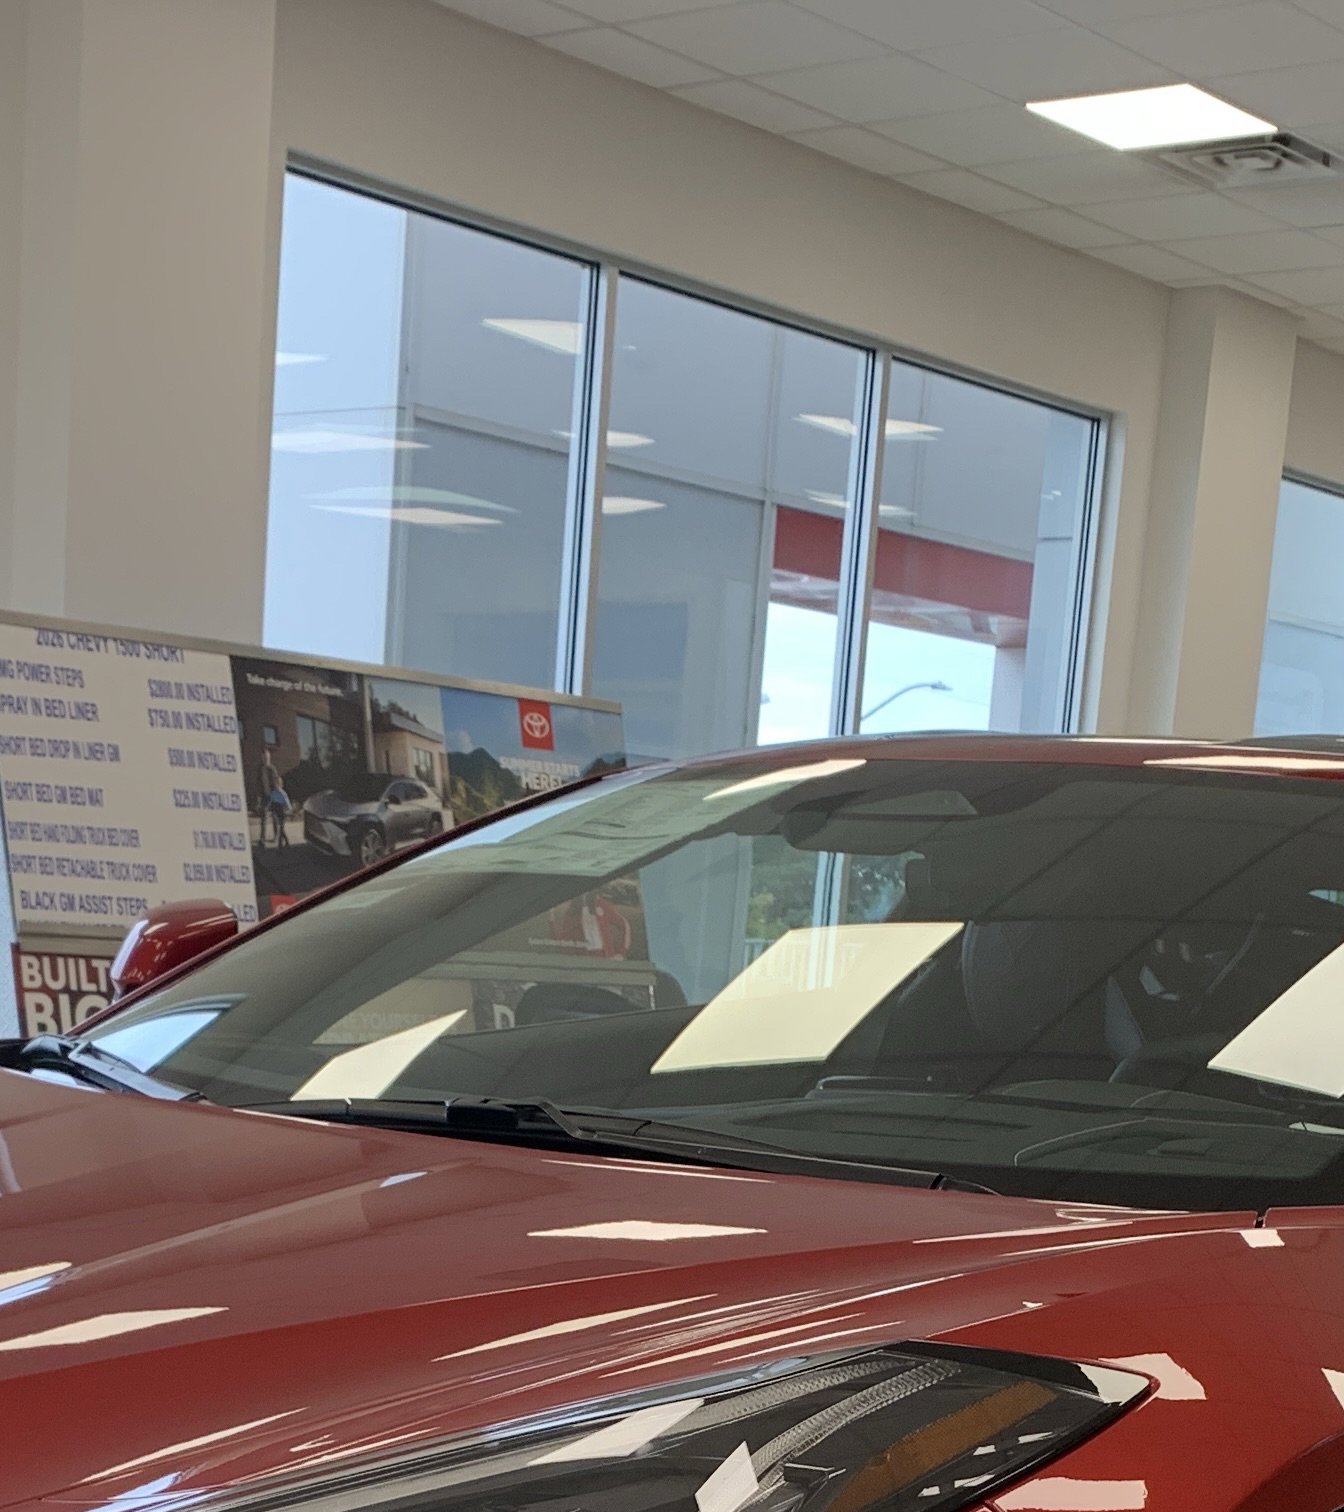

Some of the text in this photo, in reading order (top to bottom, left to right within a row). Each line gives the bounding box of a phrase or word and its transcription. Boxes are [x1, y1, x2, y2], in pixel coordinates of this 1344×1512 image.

[67, 632, 110, 654] CHEVY
[114, 637, 141, 658] 1500
[144, 643, 186, 664] SHORT
[16, 660, 52, 684] POWER
[54, 666, 85, 689] STEPS
[186, 683, 233, 705] INSTALLED
[30, 696, 42, 716] IN
[44, 698, 66, 719] BED
[68, 701, 99, 722] LINER
[185, 711, 236, 734] INSTALLED
[28, 736, 47, 757] BED
[82, 741, 107, 761] LINER
[197, 751, 237, 772] INSTALLED
[499, 756, 580, 777] SUMMER STARTS
[4, 780, 33, 801] SHORT
[35, 782, 54, 803] BED
[68, 786, 87, 806] BED
[87, 787, 104, 808] MAT
[201, 791, 242, 812] INSTALLED
[10, 853, 36, 874] SHORT
[38, 856, 54, 875] BED
[106, 861, 131, 882] TRUCK
[132, 863, 158, 883] COVER
[214, 864, 250, 884] INSTALLED
[20, 889, 149, 917] BLACK GM ASSIST STEPS
[20, 954, 110, 993] BUILT
